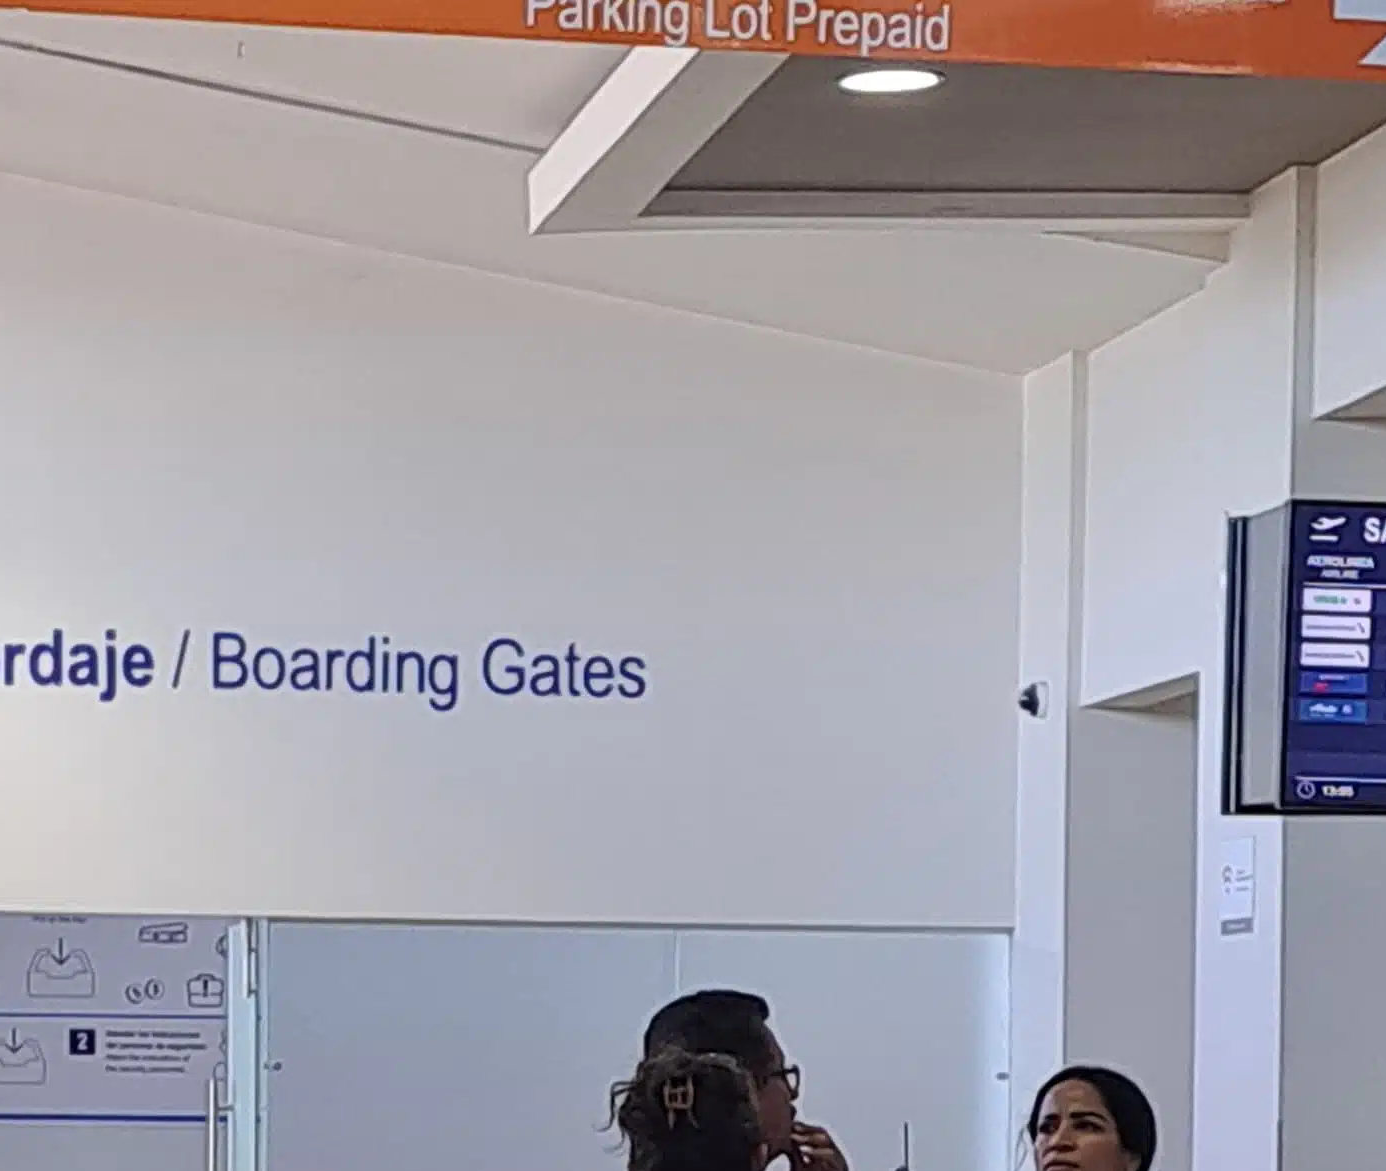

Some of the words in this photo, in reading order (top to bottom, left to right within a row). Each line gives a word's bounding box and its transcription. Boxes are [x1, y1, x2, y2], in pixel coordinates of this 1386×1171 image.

[524, 0, 688, 46] Parking
[704, 0, 771, 41] Lot
[787, 1, 949, 54] Prepaid
[172, 628, 190, 688] /
[212, 631, 459, 711] Boarding
[481, 638, 646, 698] Gates
[76, 1032, 88, 1051] 2
